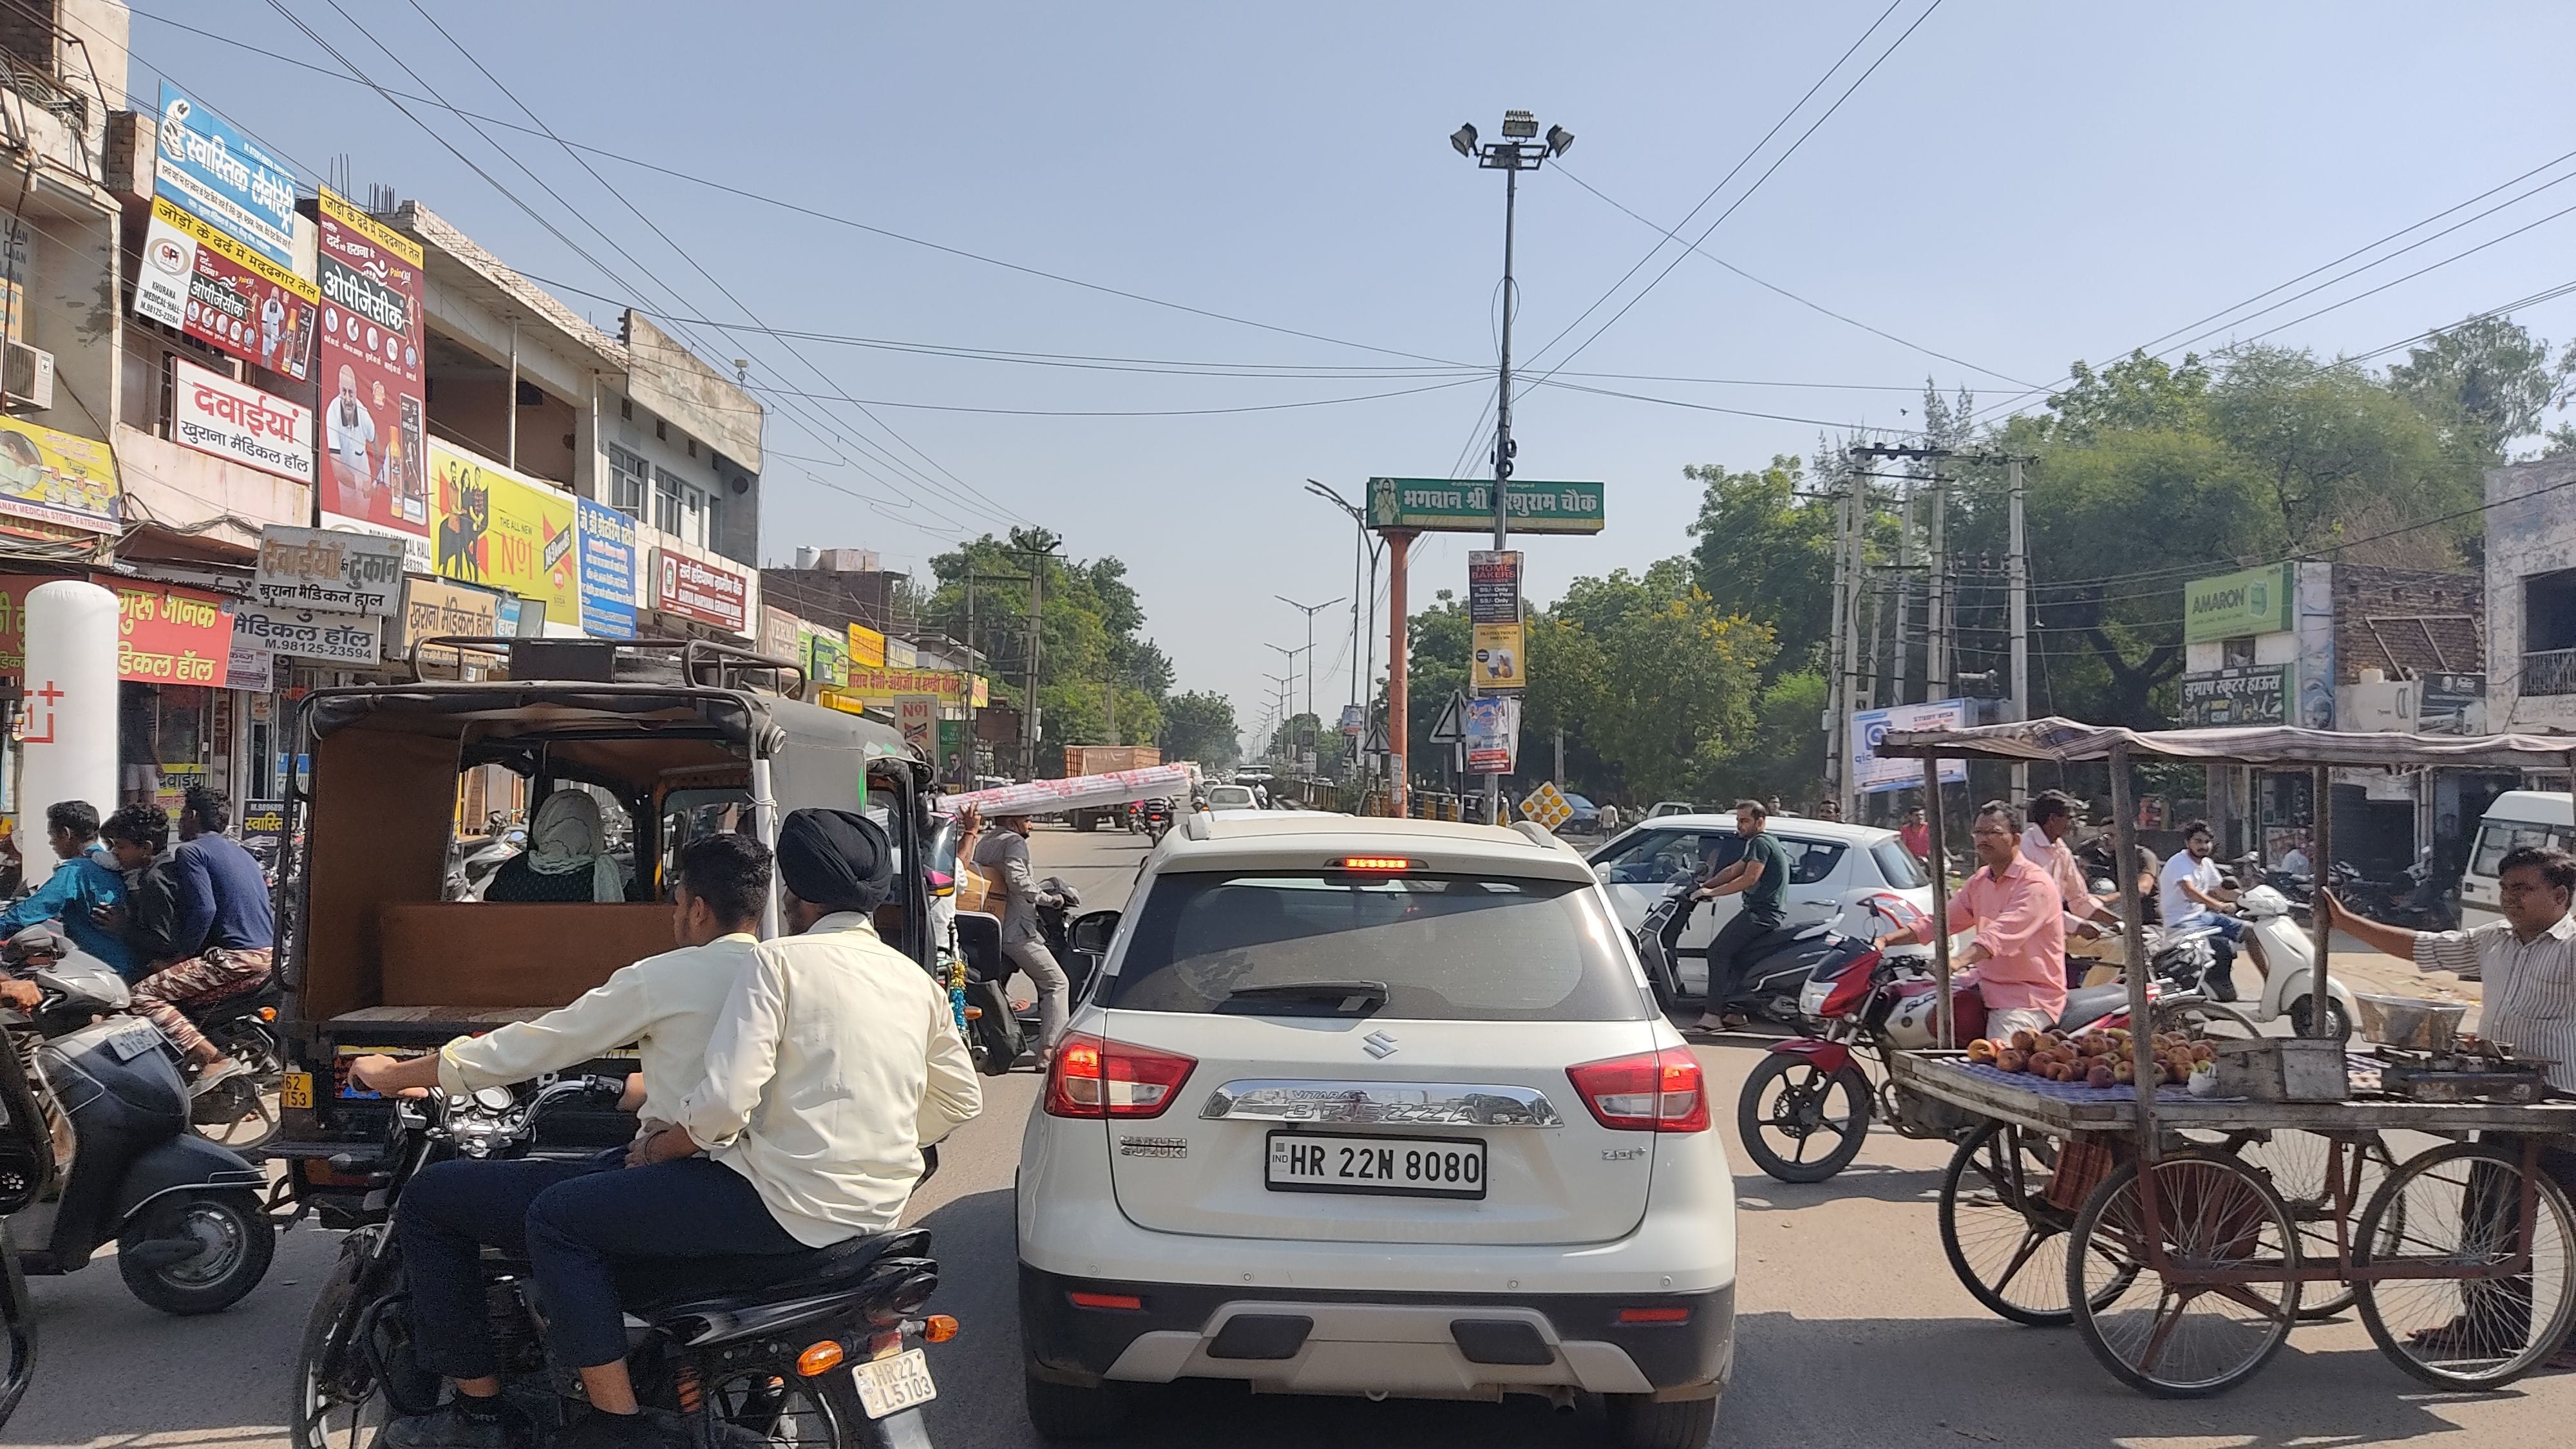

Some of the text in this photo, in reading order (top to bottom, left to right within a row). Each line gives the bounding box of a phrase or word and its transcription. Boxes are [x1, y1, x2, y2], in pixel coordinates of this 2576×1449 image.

[185, 129, 250, 193] स्वास्तिक
[5, 218, 28, 244] LAN
[159, 204, 194, 231] जोड़ों
[196, 223, 210, 239] के
[214, 234, 233, 254] दर्द
[236, 244, 247, 260] में
[299, 277, 316, 298] तेल
[326, 233, 341, 251] दर्द
[346, 242, 368, 258] हराना
[408, 242, 420, 263] तेल
[143, 290, 180, 314] MEDICAL HALL
[152, 281, 176, 300] KHURANA
[193, 381, 299, 444] दवाईयां
[181, 421, 309, 473] खुराना मैडिकल हॉल
[1403, 487, 1597, 516] भगवान श्री रशुराम चौक
[19, 504, 49, 518] MEDICAL
[76, 516, 112, 531] FATEHABAD
[500, 516, 533, 536] THE ALL NEW
[417, 541, 430, 560] HALL
[347, 551, 401, 589] दुकान
[259, 583, 297, 599] खुराना
[298, 584, 352, 603] मैडिकल
[2192, 587, 2244, 614] AMARON
[234, 612, 374, 648] मैडिकल हॉल
[118, 641, 216, 681] डिकल हॉल
[265, 638, 372, 659] M.98125-23594
[1293, 1090, 1350, 1100] VITARA
[1285, 1101, 1481, 1123] BREZZA
[1121, 1135, 1186, 1146] MARUTI
[1121, 1146, 1186, 1159] SUZUKI
[1273, 1155, 1288, 1163] IND
[1291, 1144, 1479, 1183] HR 22N 8080
[873, 1357, 917, 1386] HR22
[880, 1376, 932, 1409] L5103
